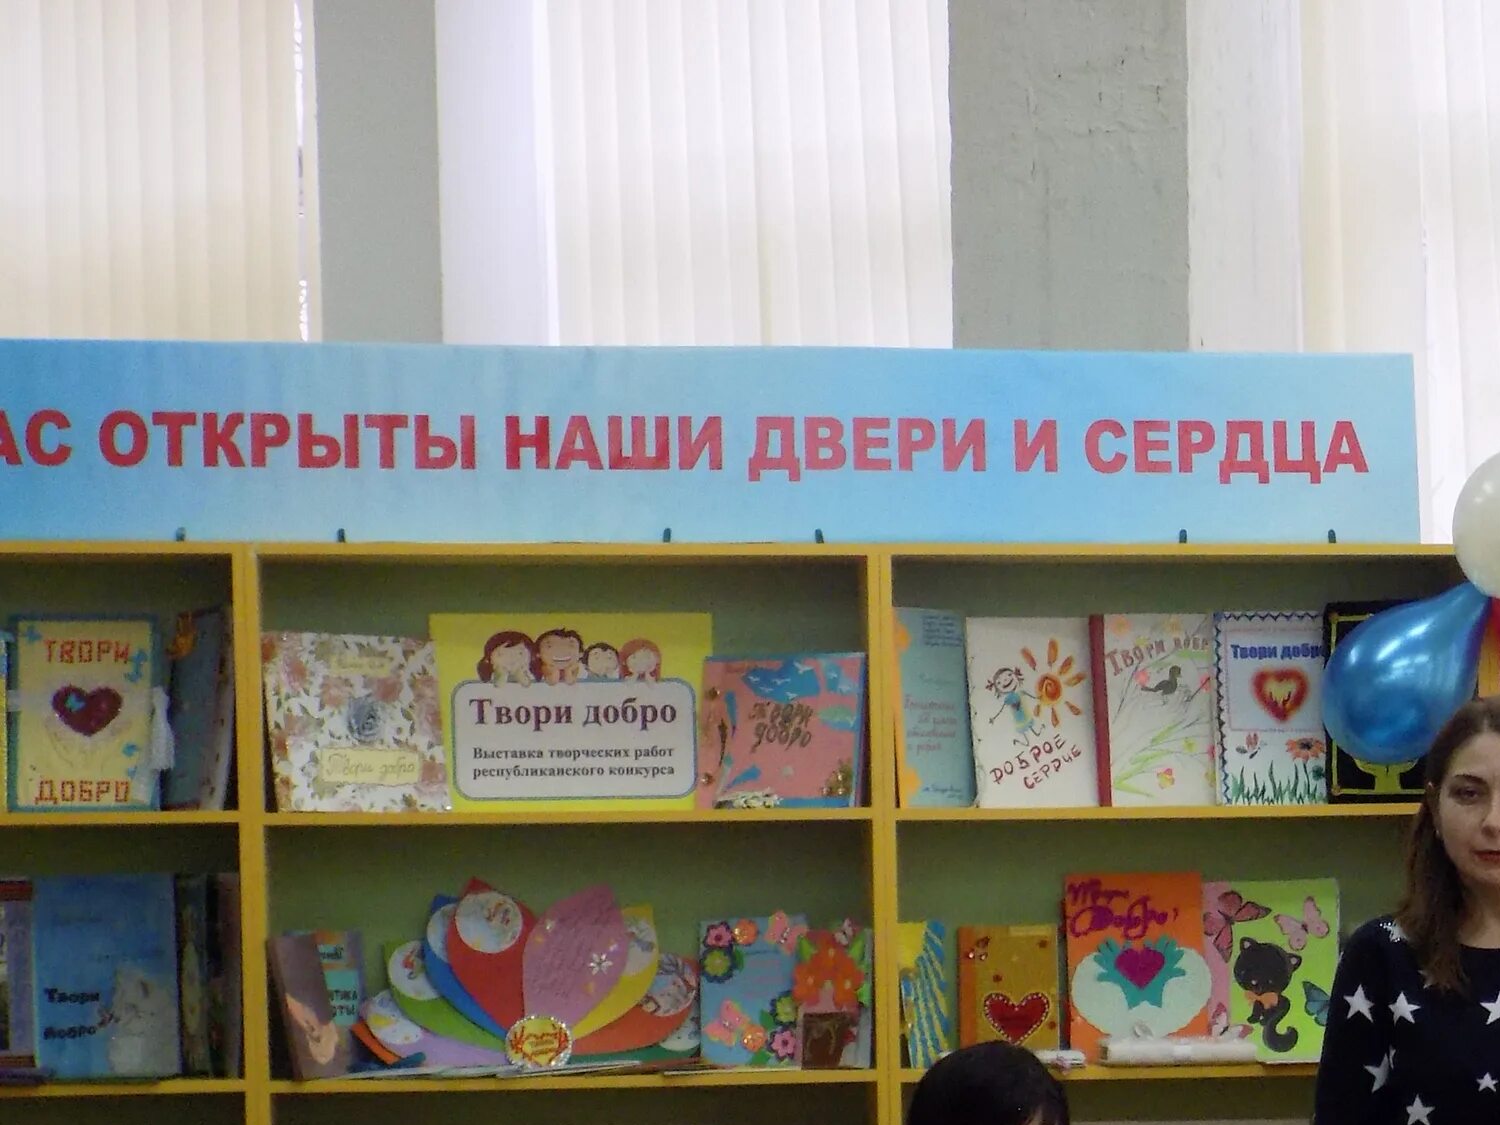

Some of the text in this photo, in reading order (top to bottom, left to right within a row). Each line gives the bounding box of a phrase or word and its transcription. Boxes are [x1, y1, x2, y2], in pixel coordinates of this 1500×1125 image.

[100, 410, 477, 470] ОТКРЫТЫ
[506, 415, 723, 471] НАШИ
[748, 416, 987, 482] ДВЕРИ
[1014, 420, 1058, 472] И
[1084, 419, 1369, 484] СЕРДЦА
[43, 640, 131, 664] ТВОРИ
[1230, 643, 1278, 660] Твори
[469, 697, 677, 731] Твори добро
[472, 746, 675, 760] Выставка творческих работ
[989, 734, 1067, 785] ДОБРОЕ
[472, 765, 675, 780] республиканского конкурса
[35, 779, 130, 805] ДОБРО
